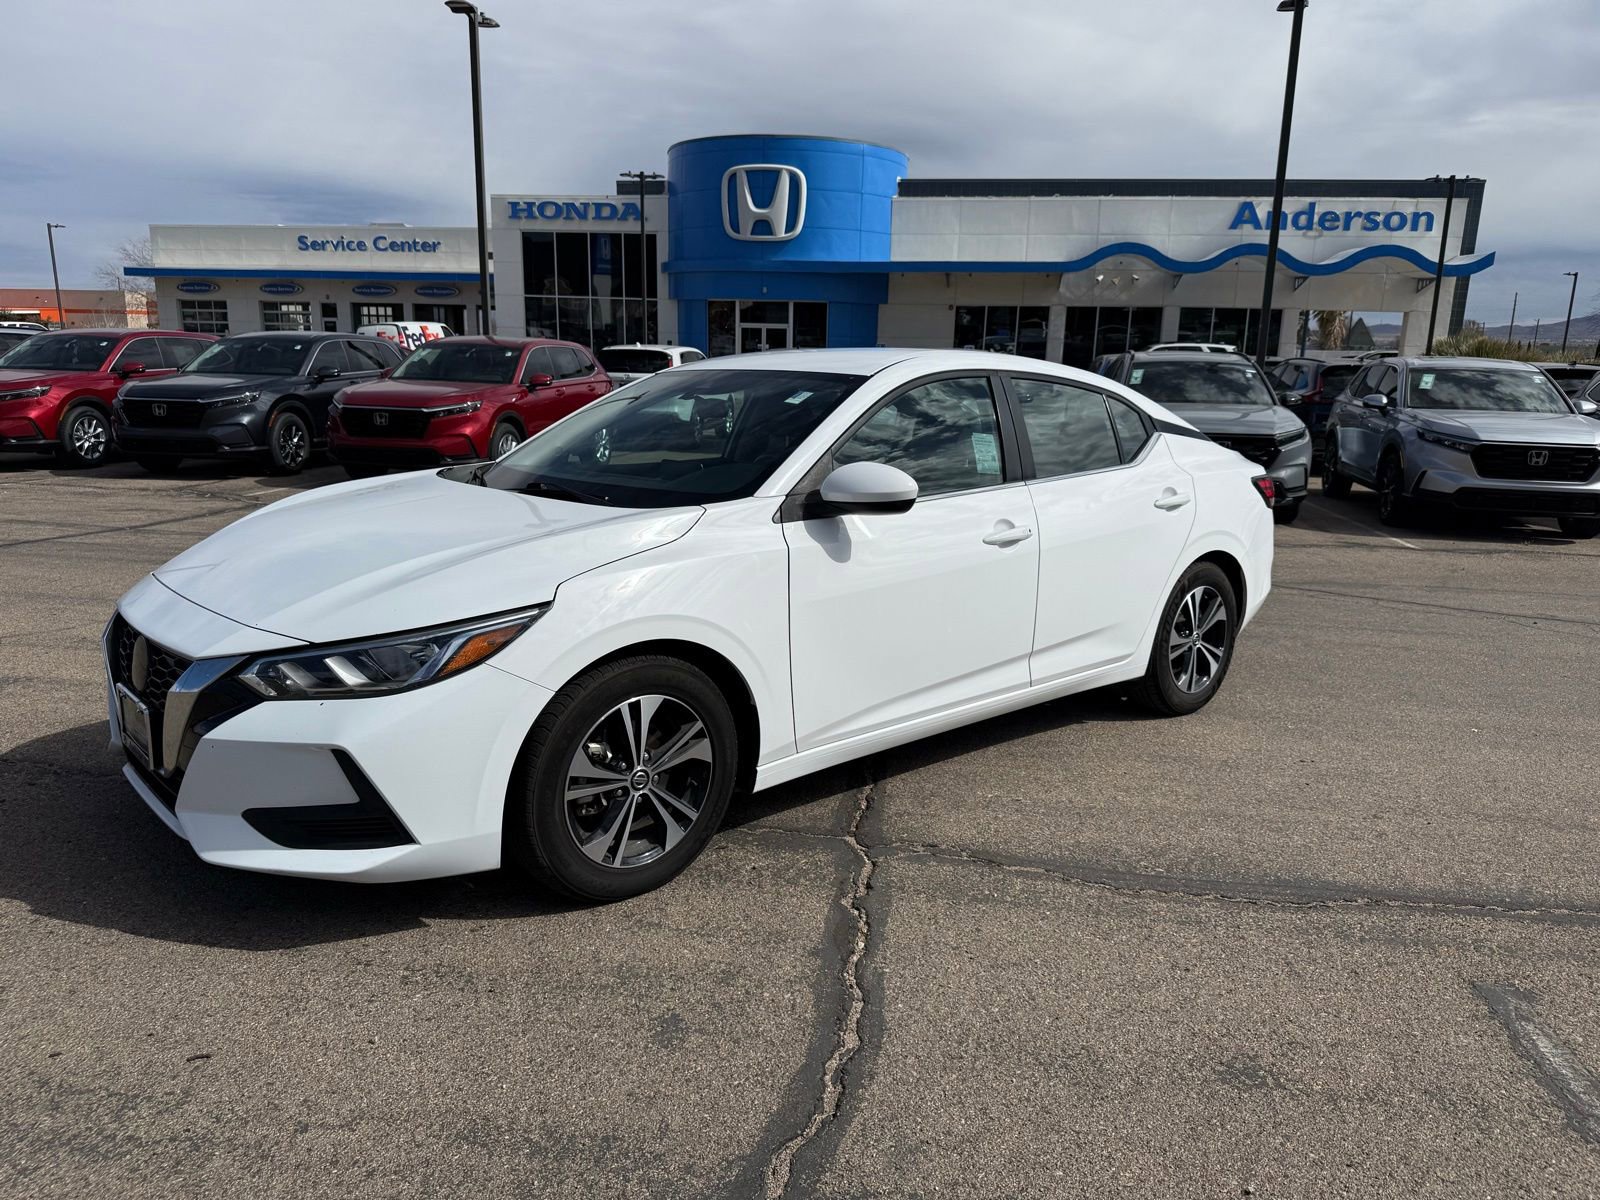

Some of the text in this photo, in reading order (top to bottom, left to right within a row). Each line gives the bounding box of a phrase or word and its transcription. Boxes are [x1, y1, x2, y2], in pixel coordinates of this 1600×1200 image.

[507, 201, 647, 221] HONDA
[1228, 201, 1435, 232] Anderson
[297, 234, 441, 252] Service Center
